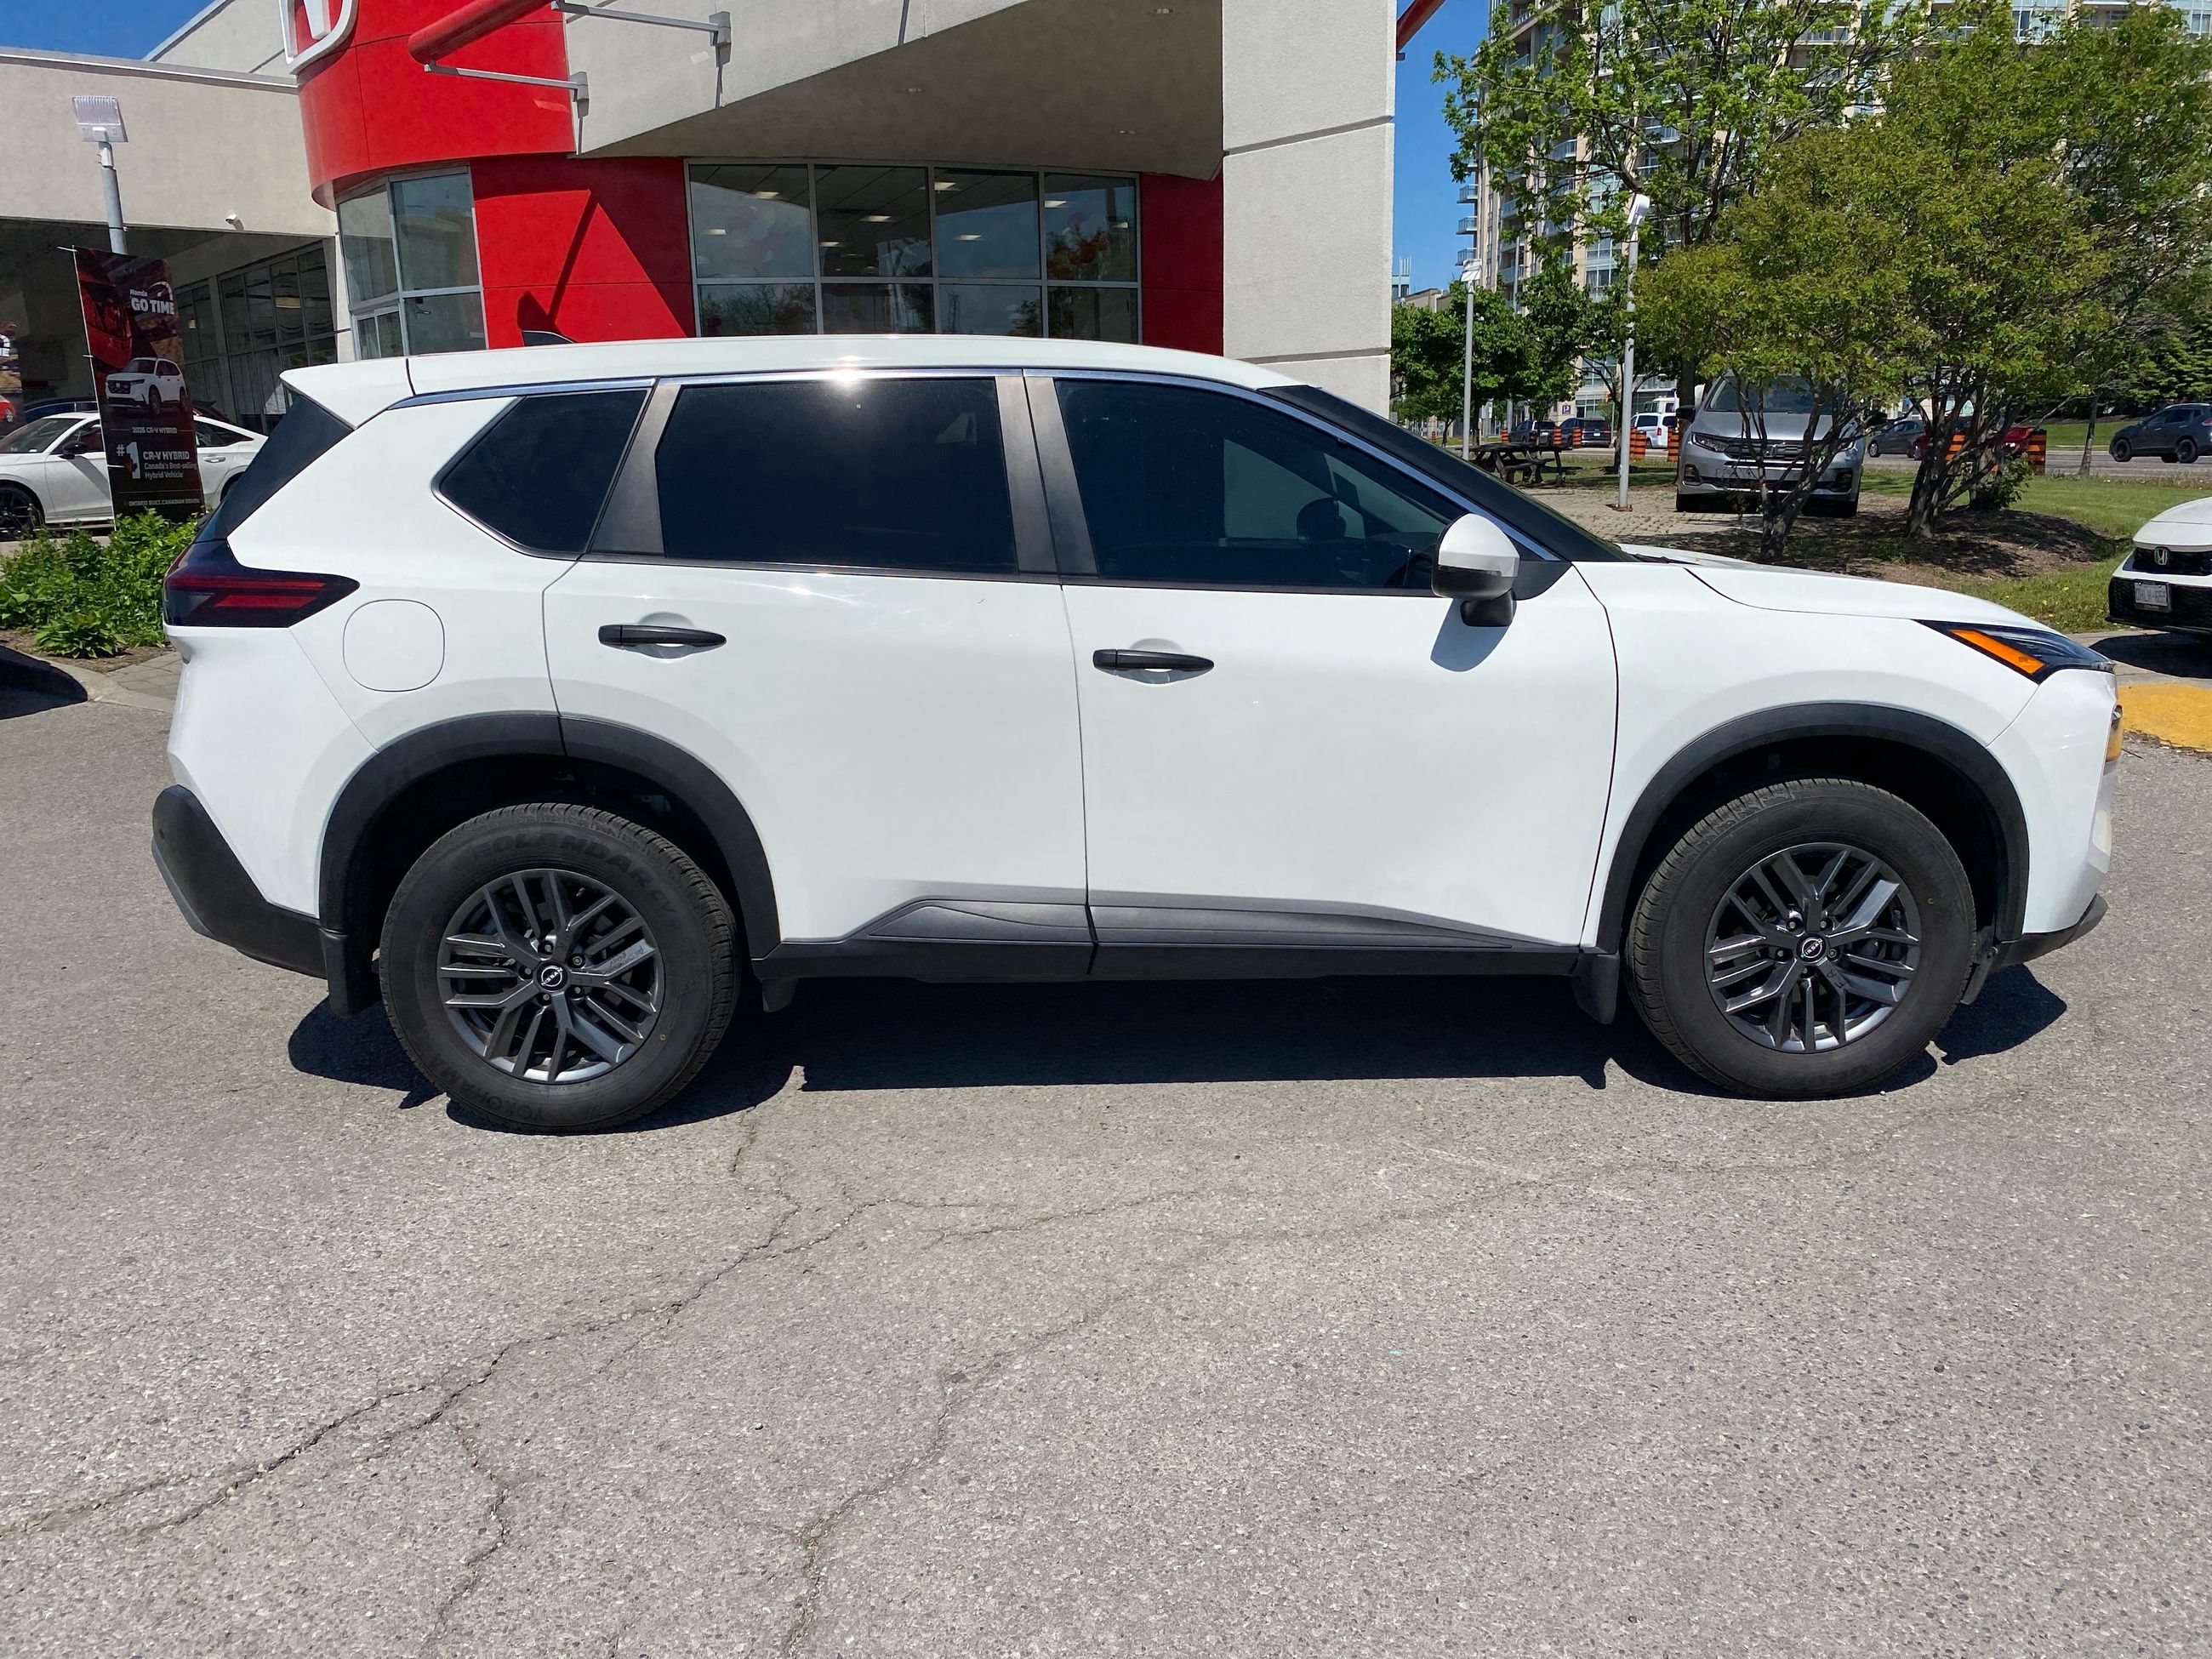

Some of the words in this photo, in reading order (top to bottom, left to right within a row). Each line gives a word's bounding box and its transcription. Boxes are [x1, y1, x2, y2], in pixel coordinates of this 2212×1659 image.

[131, 298, 149, 311] GO
[150, 299, 174, 315] TIME
[117, 442, 140, 478] #1
[143, 451, 161, 460] CR-V
[162, 451, 190, 460] HYBRID
[145, 470, 164, 481] Hybrid
